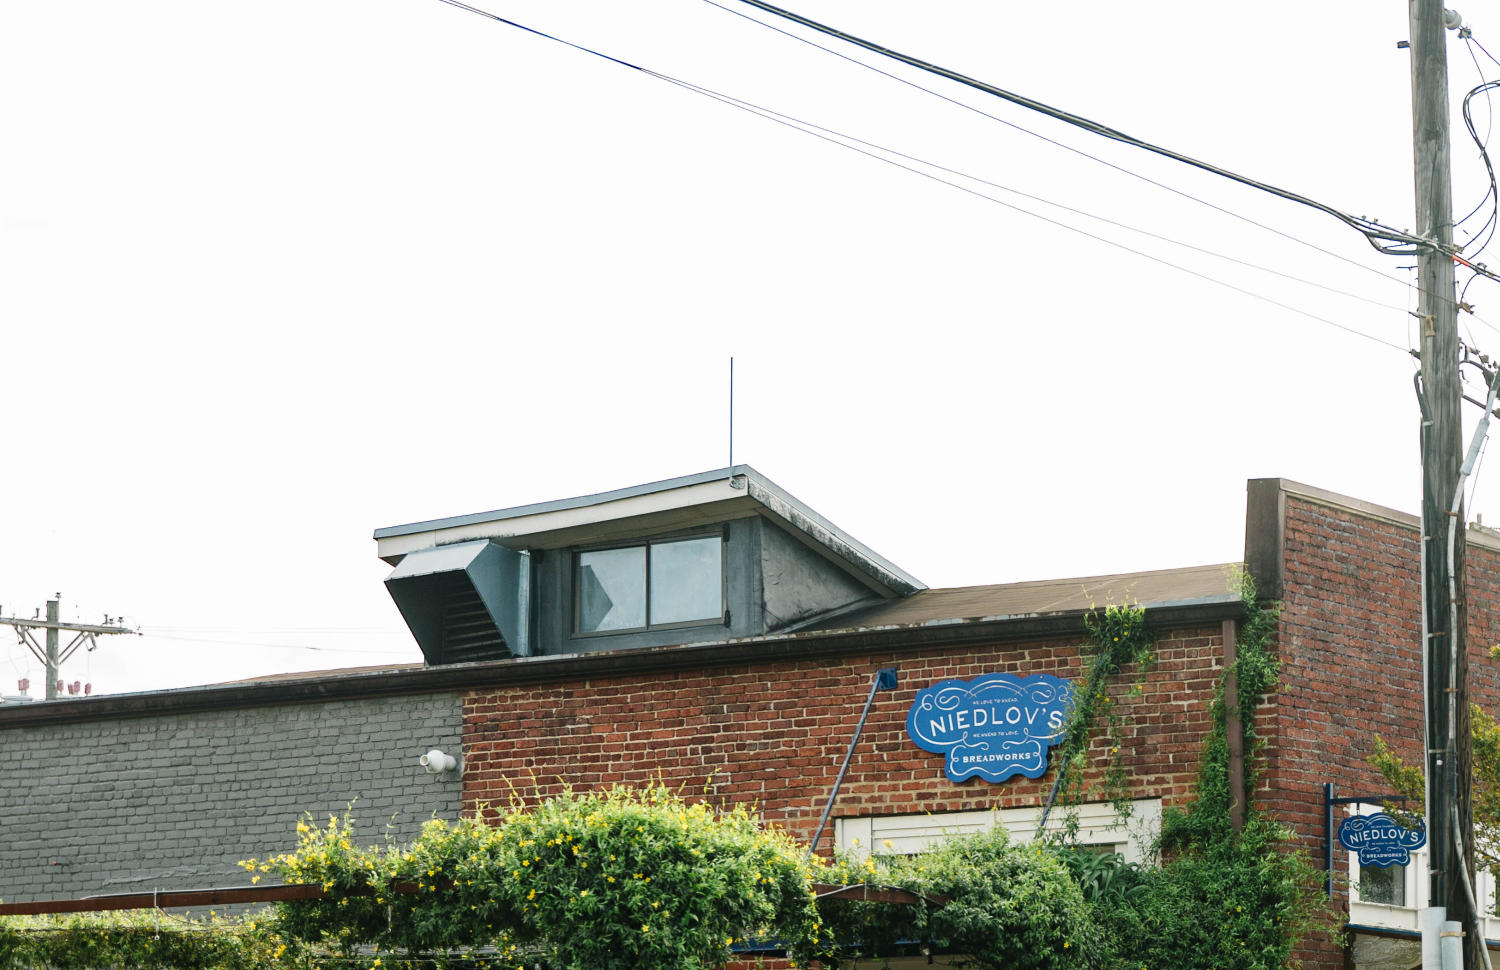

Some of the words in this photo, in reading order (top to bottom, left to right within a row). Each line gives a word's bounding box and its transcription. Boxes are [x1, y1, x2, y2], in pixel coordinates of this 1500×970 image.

[929, 706, 1064, 737] NIEDLOV'S
[962, 752, 1031, 763] BREADWORKS
[1349, 828, 1419, 844] NIEDLOV'S
